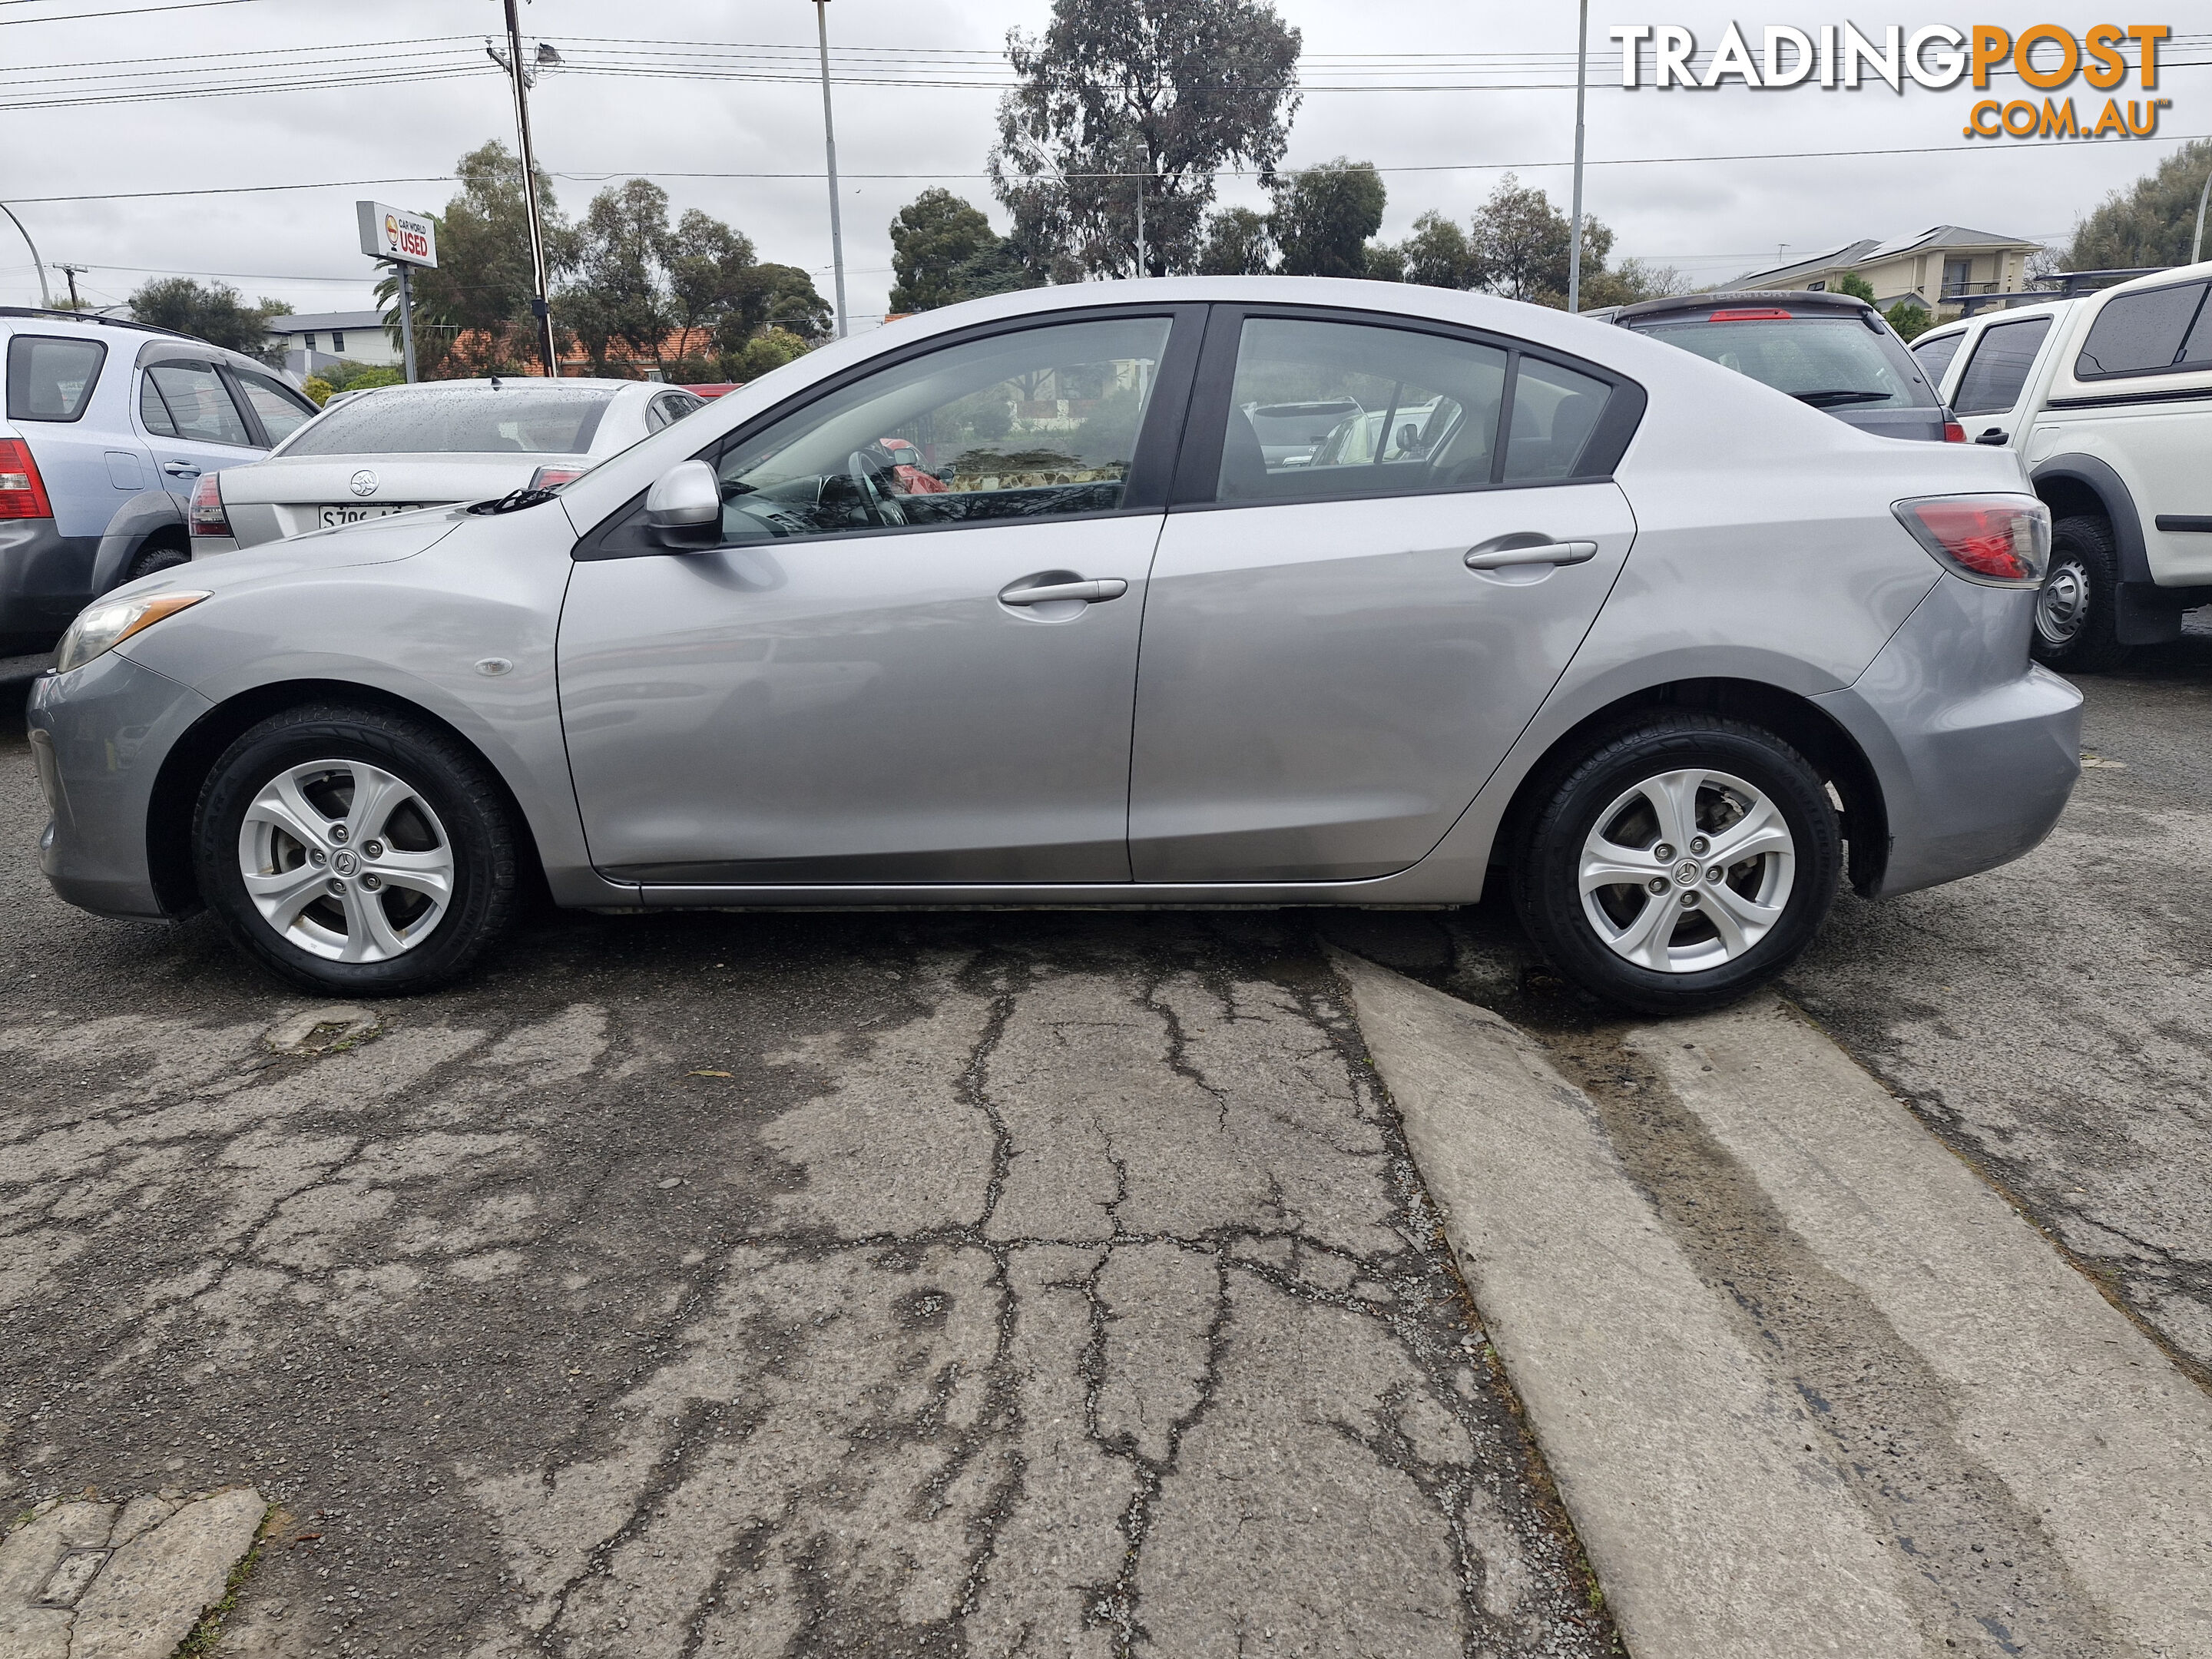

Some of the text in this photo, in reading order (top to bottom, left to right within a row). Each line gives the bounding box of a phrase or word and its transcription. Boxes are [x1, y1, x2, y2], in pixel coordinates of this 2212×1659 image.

[399, 219, 426, 234] CAR WORLD
[399, 230, 428, 257] USED
[1705, 290, 1793, 301] TERRITORY
